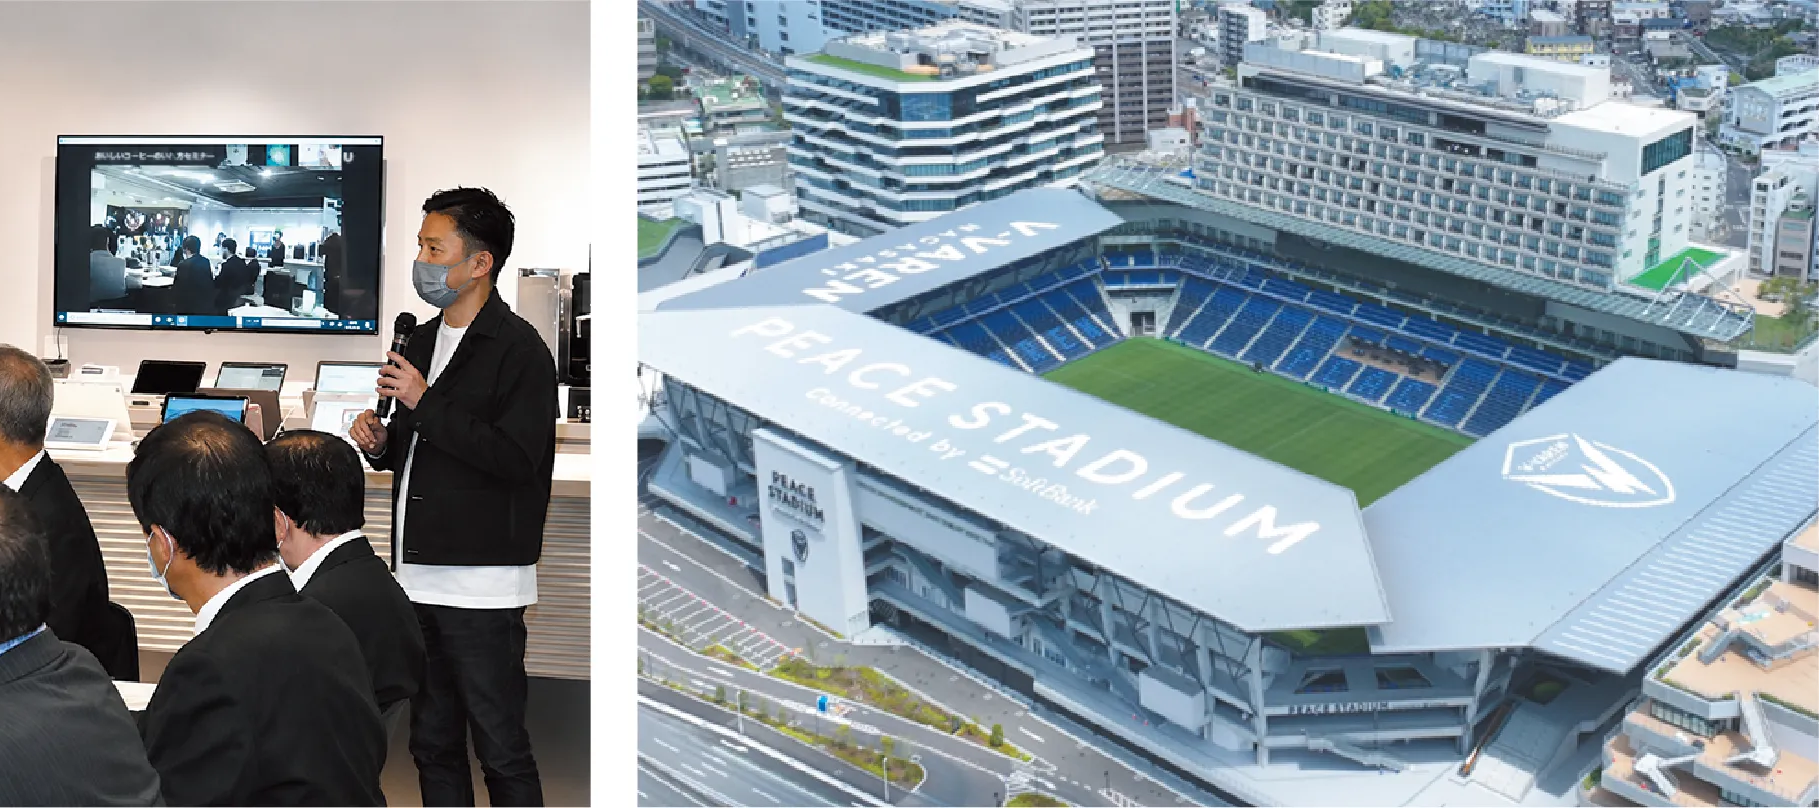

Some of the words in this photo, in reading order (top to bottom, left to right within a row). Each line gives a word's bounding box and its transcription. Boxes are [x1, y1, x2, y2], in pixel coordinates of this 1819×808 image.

[802, 221, 1061, 303] V-VAREN
[730, 316, 958, 408] PEACE
[948, 401, 1321, 555] STADIUM
[804, 387, 932, 444] Connected
[929, 437, 967, 461] by
[998, 466, 1101, 517] SoftBank
[767, 484, 825, 524] STADIUM
[771, 470, 817, 503] PEACE
